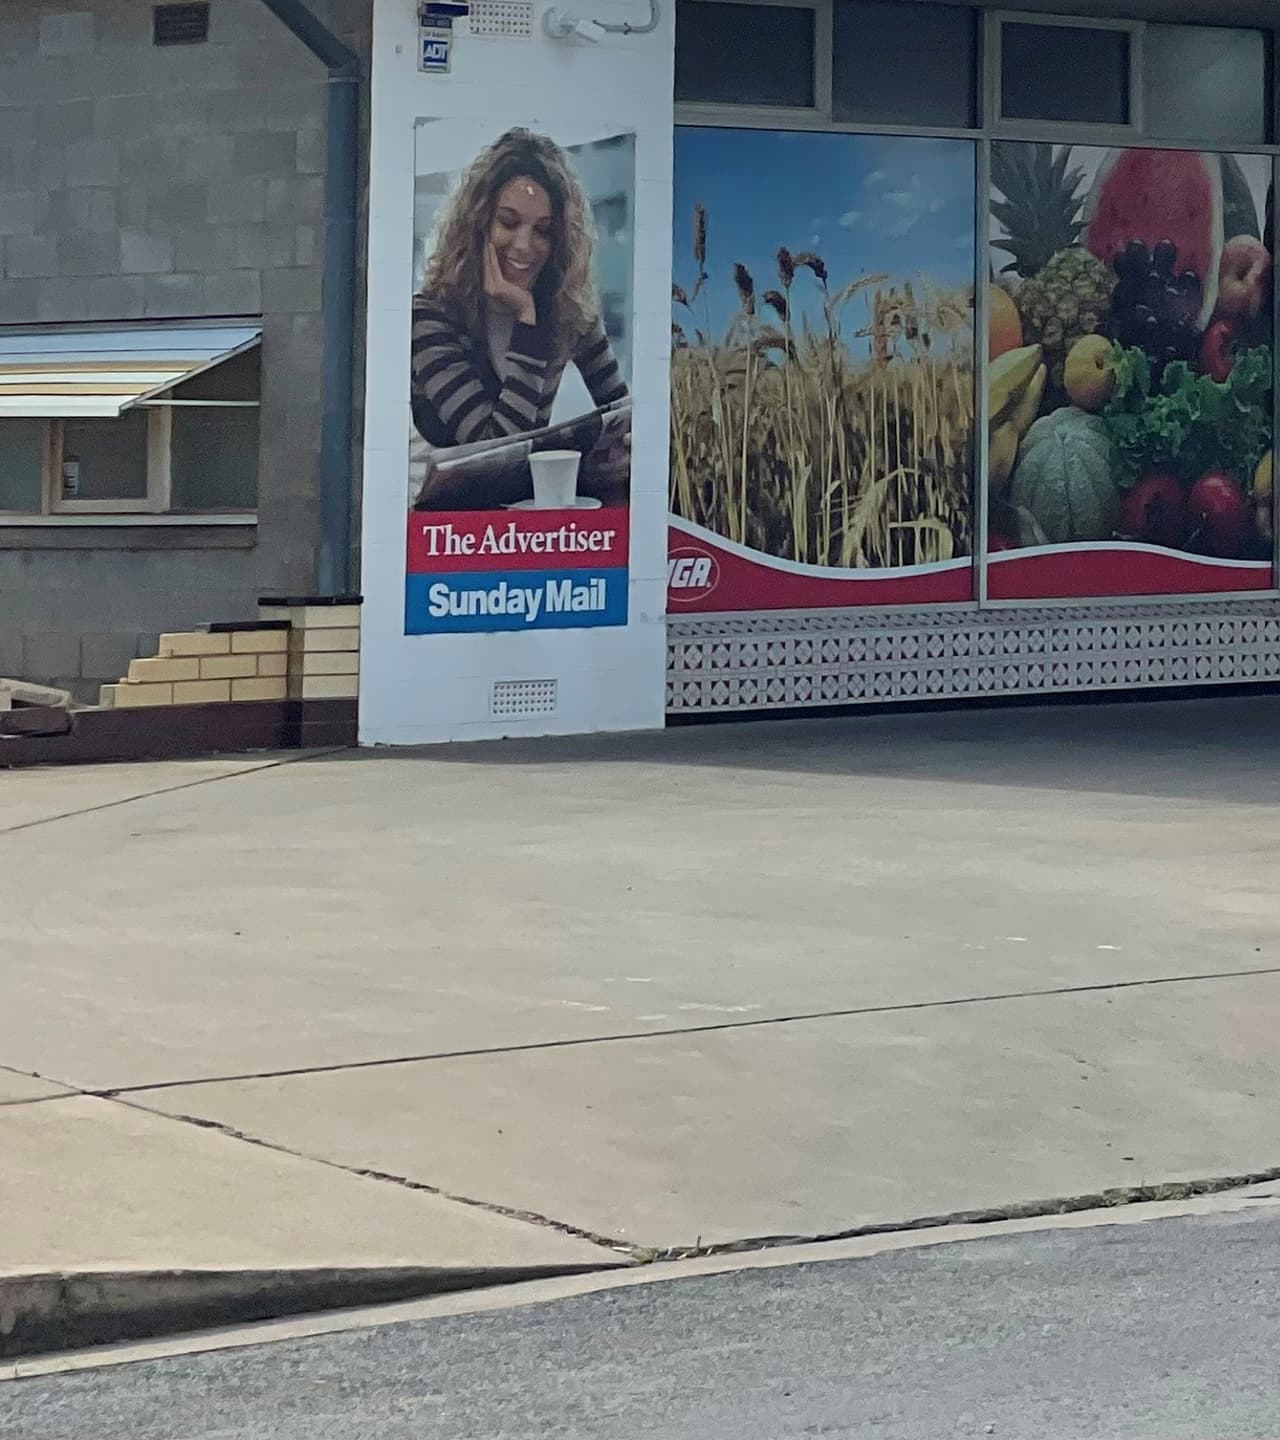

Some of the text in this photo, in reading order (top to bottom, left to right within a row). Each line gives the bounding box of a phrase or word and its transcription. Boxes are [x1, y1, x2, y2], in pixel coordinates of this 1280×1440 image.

[424, 43, 448, 60] ADT
[423, 522, 616, 556] The Advertiser
[428, 578, 607, 622] Sunday Mail
